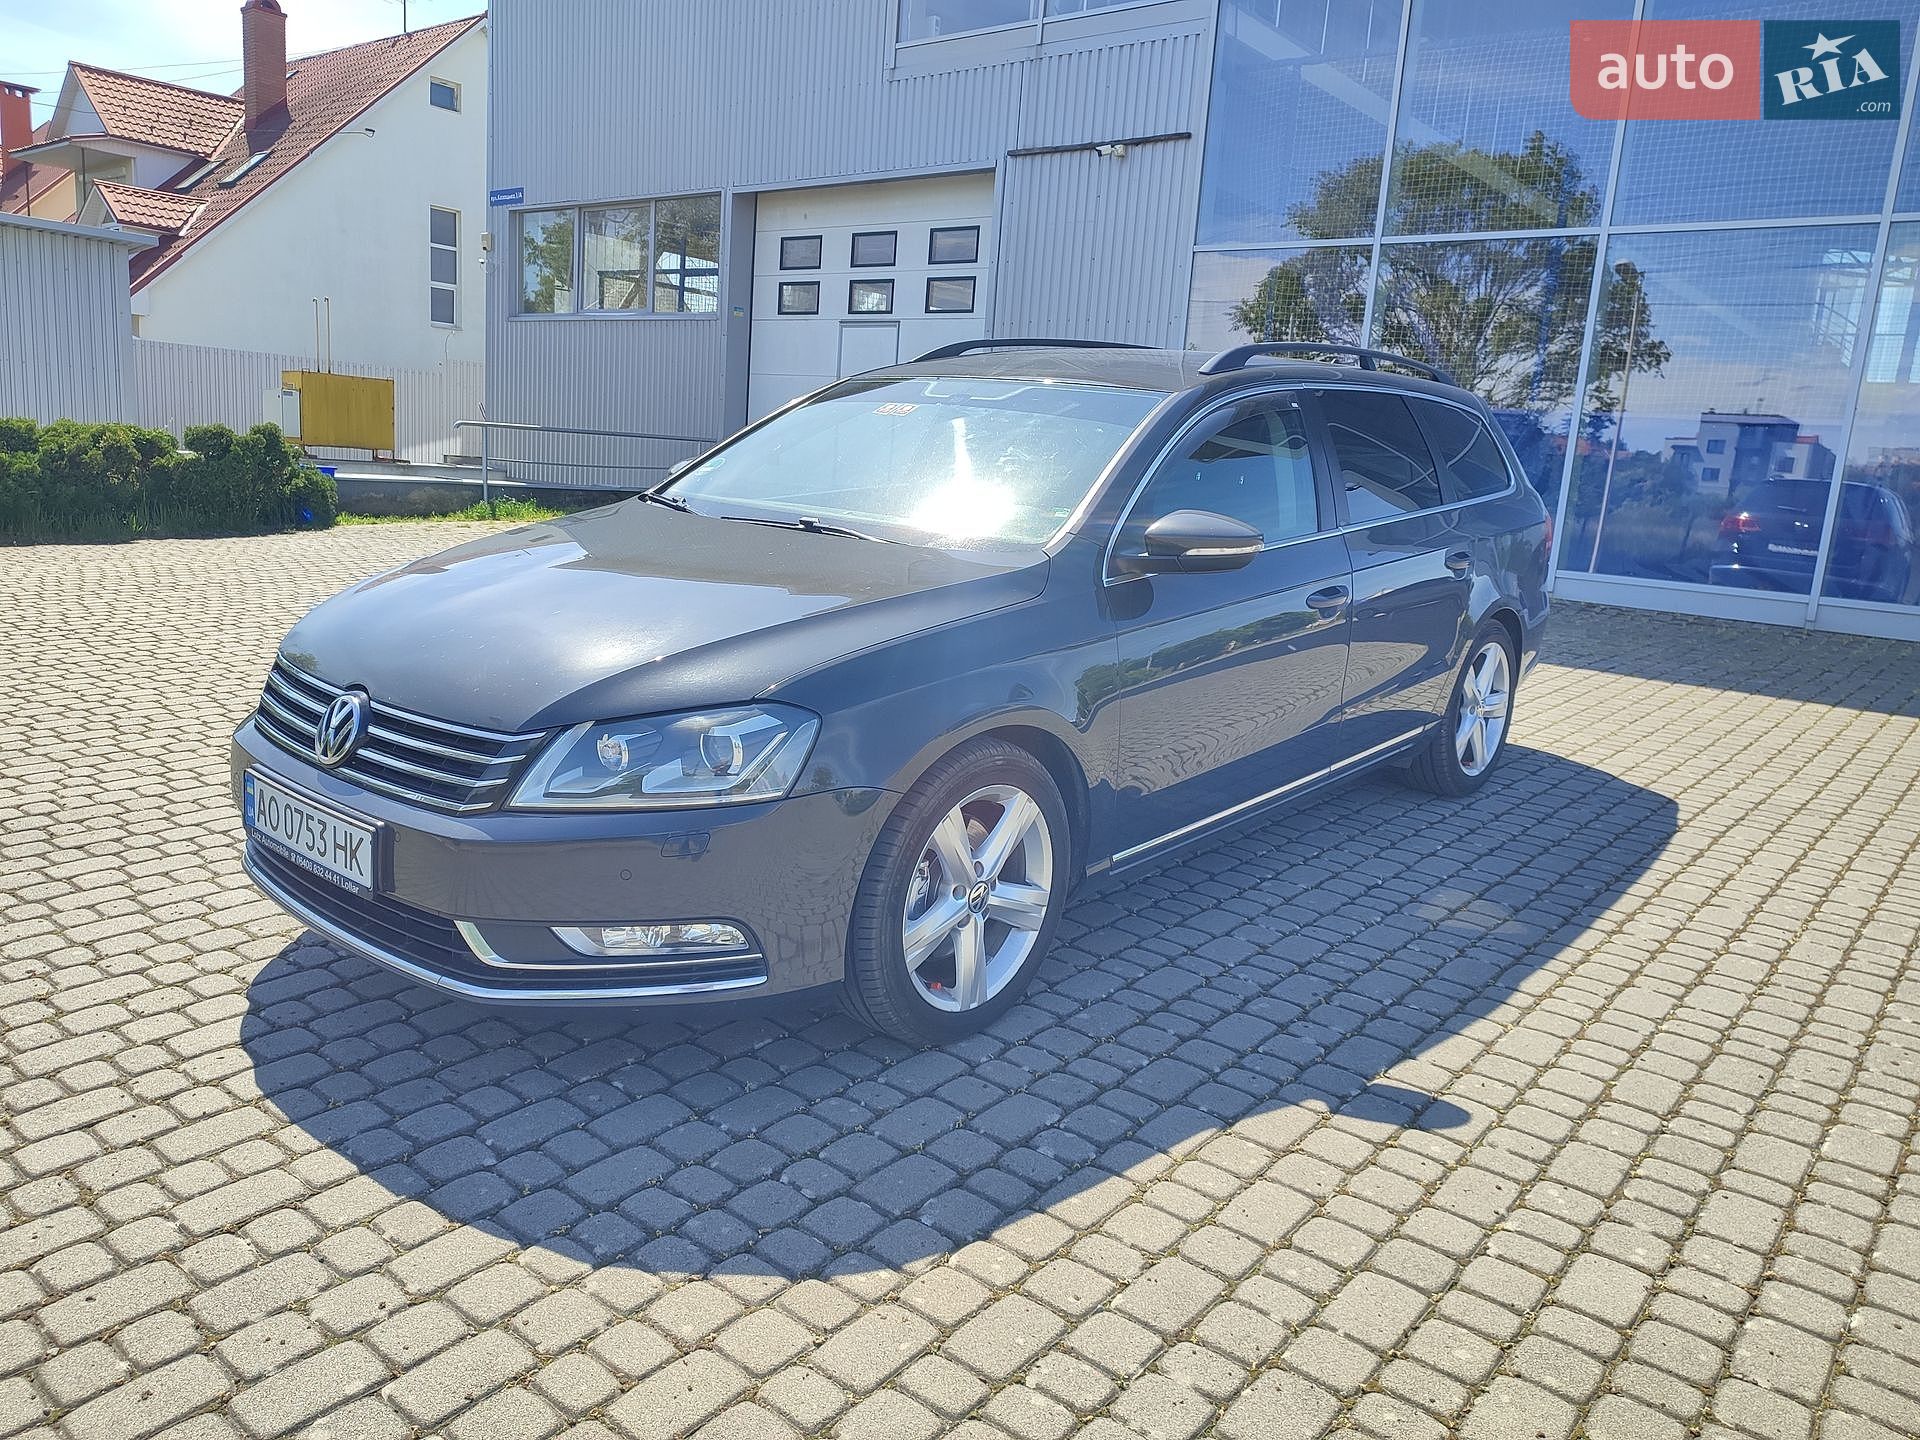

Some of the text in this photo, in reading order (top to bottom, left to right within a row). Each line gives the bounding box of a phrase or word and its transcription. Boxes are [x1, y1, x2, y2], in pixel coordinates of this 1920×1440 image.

[257, 788, 280, 832] AO
[284, 803, 327, 858] 0753
[333, 825, 364, 877] HK
